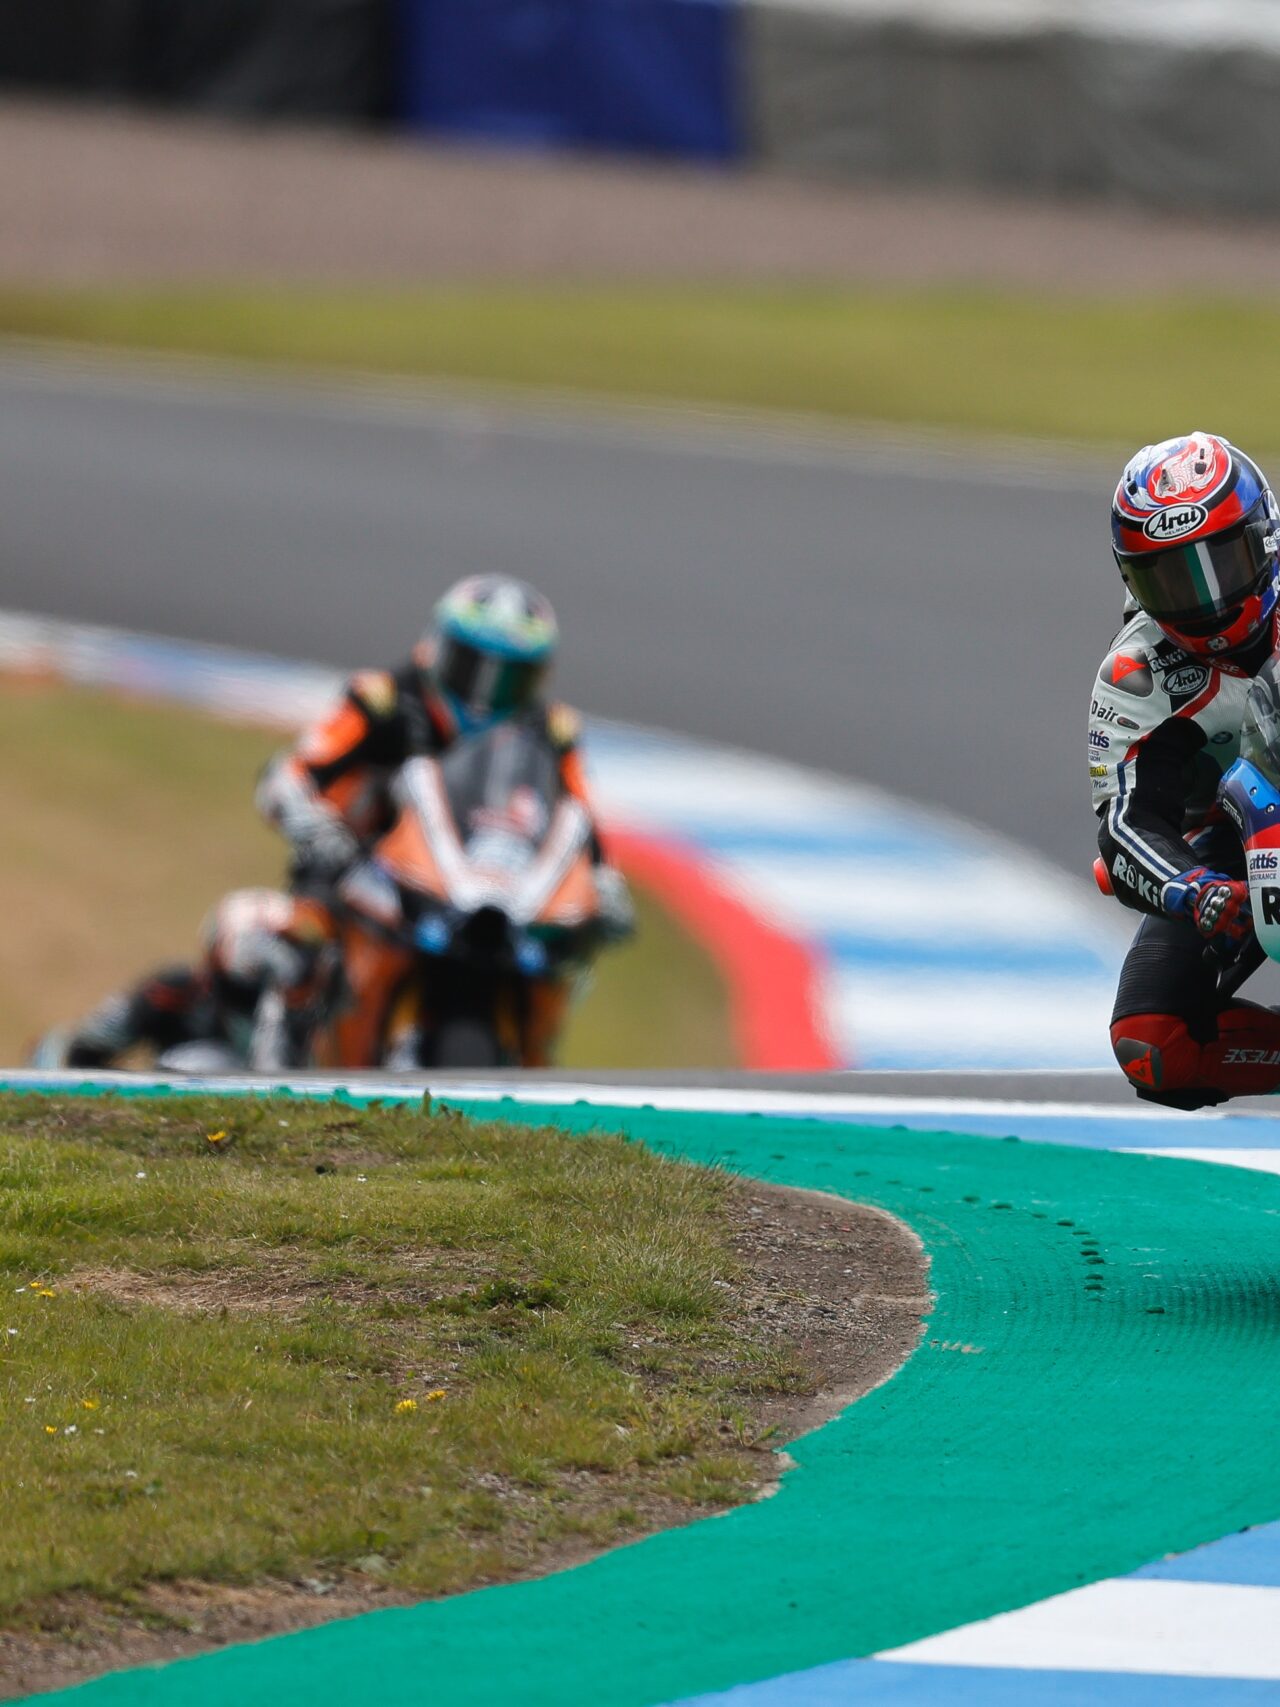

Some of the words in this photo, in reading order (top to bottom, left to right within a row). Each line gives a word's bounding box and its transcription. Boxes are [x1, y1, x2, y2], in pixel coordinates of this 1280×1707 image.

[1149, 506, 1199, 536] Arai
[1250, 852, 1278, 870] attis
[1112, 852, 1160, 908] ROKi
